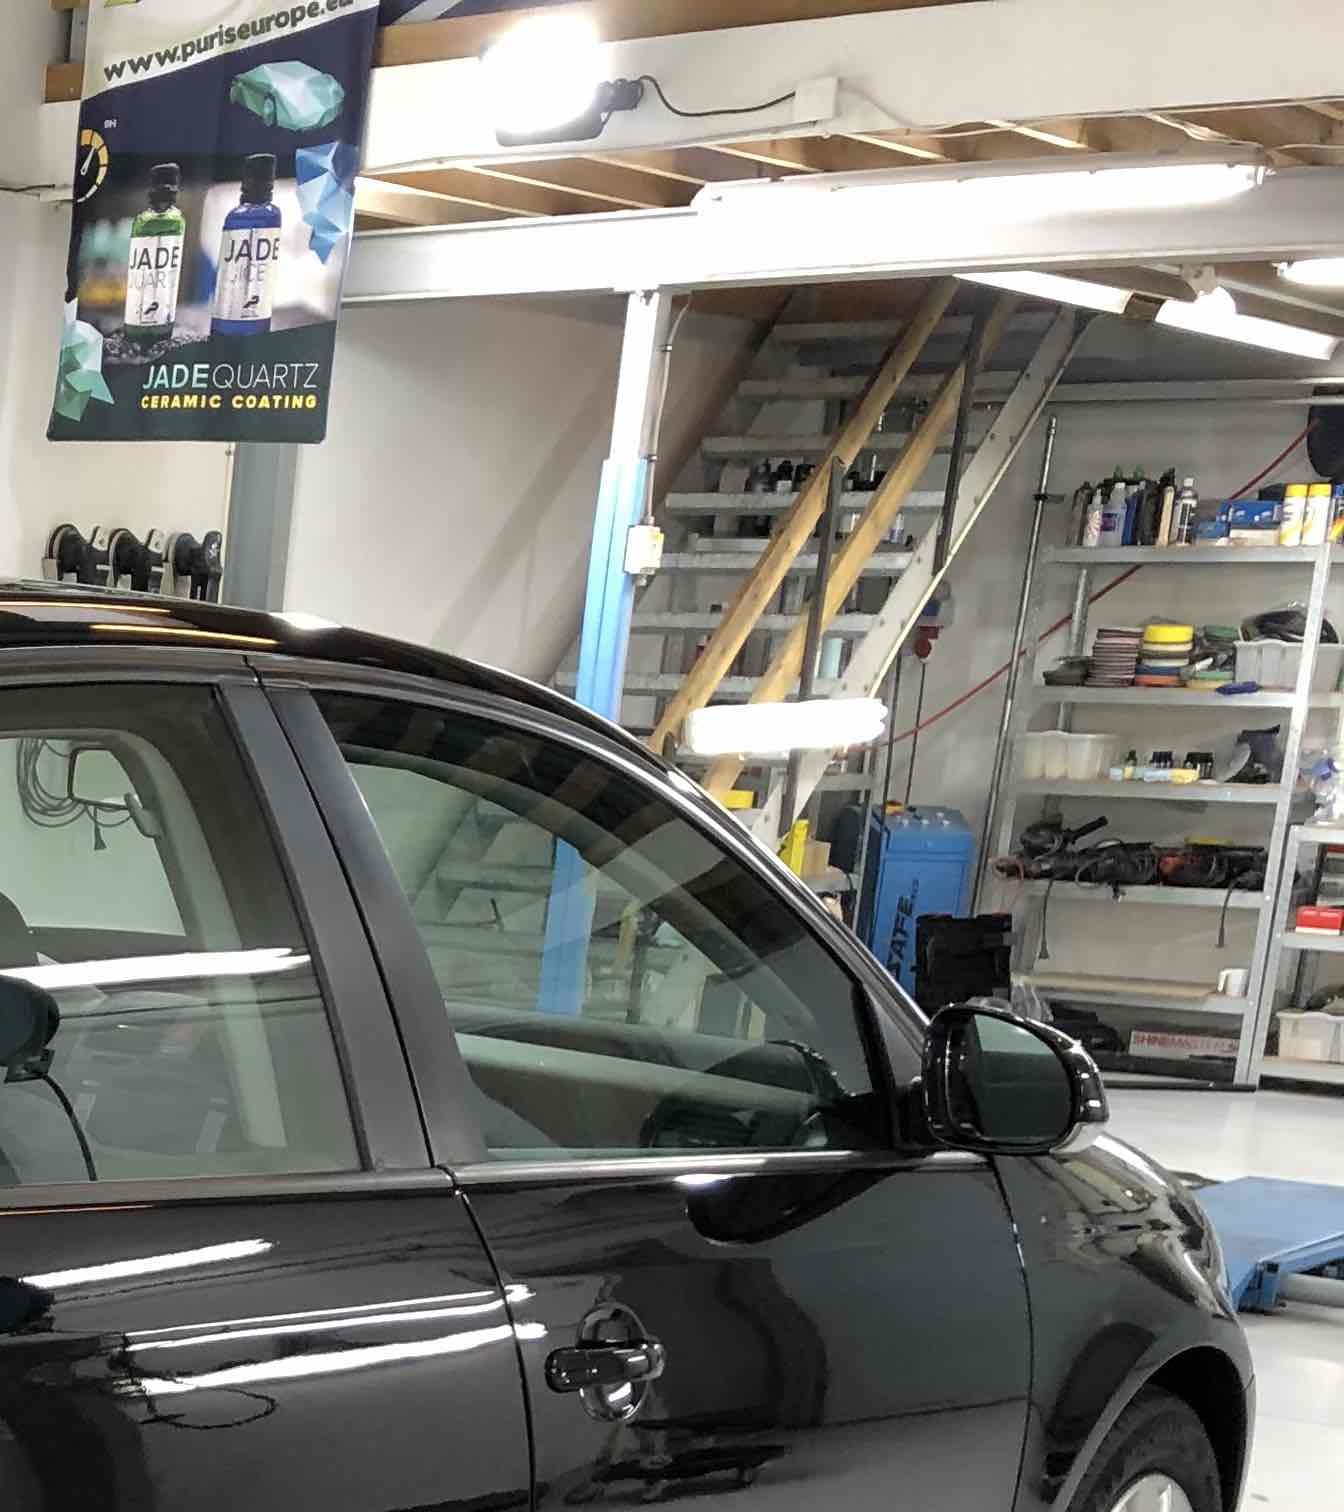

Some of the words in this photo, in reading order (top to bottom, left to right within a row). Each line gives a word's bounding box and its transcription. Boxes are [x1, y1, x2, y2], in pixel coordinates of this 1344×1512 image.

[129, 246, 180, 270] JADE
[224, 237, 280, 264] JADE
[142, 363, 319, 390] JADEQUARTZ
[140, 395, 222, 409] CERAMIC
[231, 394, 318, 409] COATING
